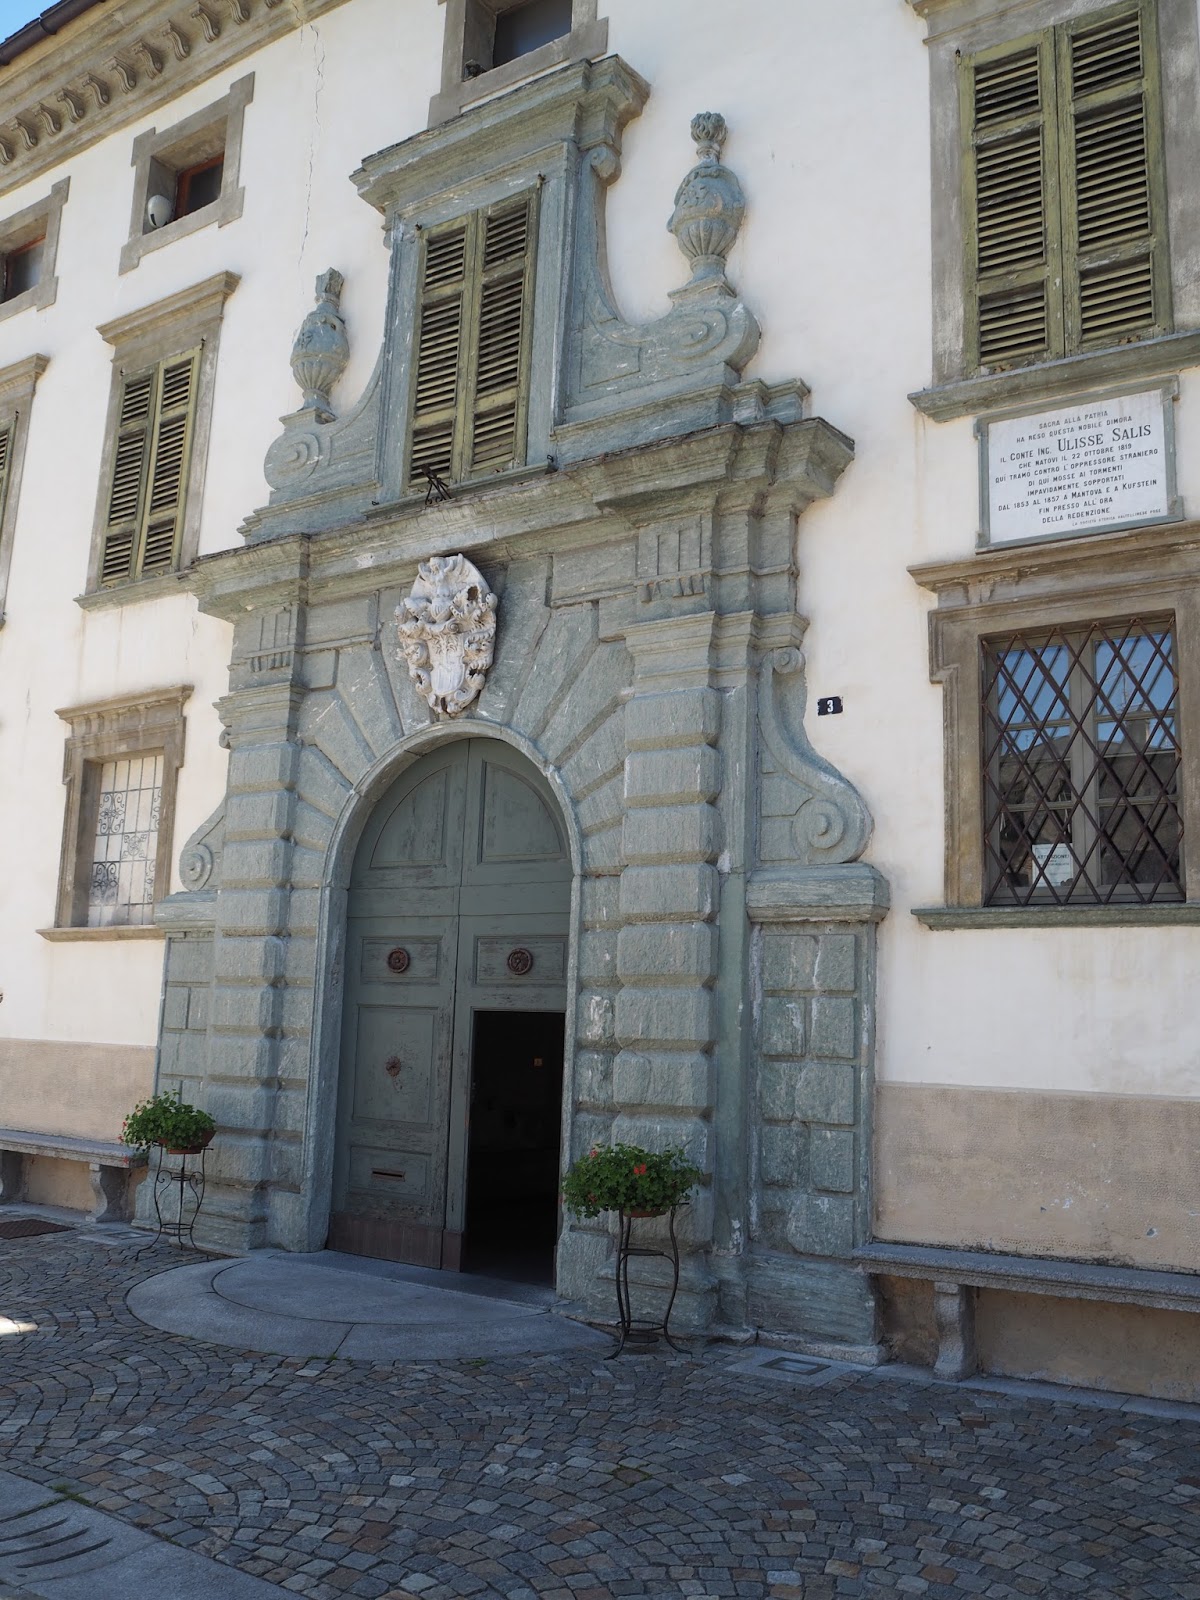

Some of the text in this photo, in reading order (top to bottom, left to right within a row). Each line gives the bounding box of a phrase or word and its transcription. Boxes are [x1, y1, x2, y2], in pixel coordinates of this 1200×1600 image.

[1028, 432, 1045, 440] RESO
[1049, 427, 1074, 437] QUESTA
[1078, 422, 1101, 430] NOBILE
[1106, 416, 1132, 426] DIMORA
[1039, 410, 1108, 429] SACRA ALLA PATRIA
[1010, 450, 1033, 460] CONTE
[1058, 434, 1103, 452] ULISSE
[1112, 424, 1151, 442] SALIS
[1034, 466, 1060, 476] CONTRO
[1120, 448, 1158, 460] STRANIERO
[1036, 457, 1058, 466] NATOVI
[1084, 446, 1113, 456] OTTOBRE
[1053, 473, 1075, 482] MOSSE
[1090, 464, 1122, 475] TORMENTI
[1028, 474, 1124, 496] IMPAVIDAMENTE SOPPORTATI
[1072, 488, 1102, 498] MANTOVA
[1122, 480, 1156, 490] KUFSTEIN
[1042, 508, 1109, 524] DELLA REDENZIONE
[1054, 502, 1079, 512] PRESSO
[827, 700, 834, 712] 3
